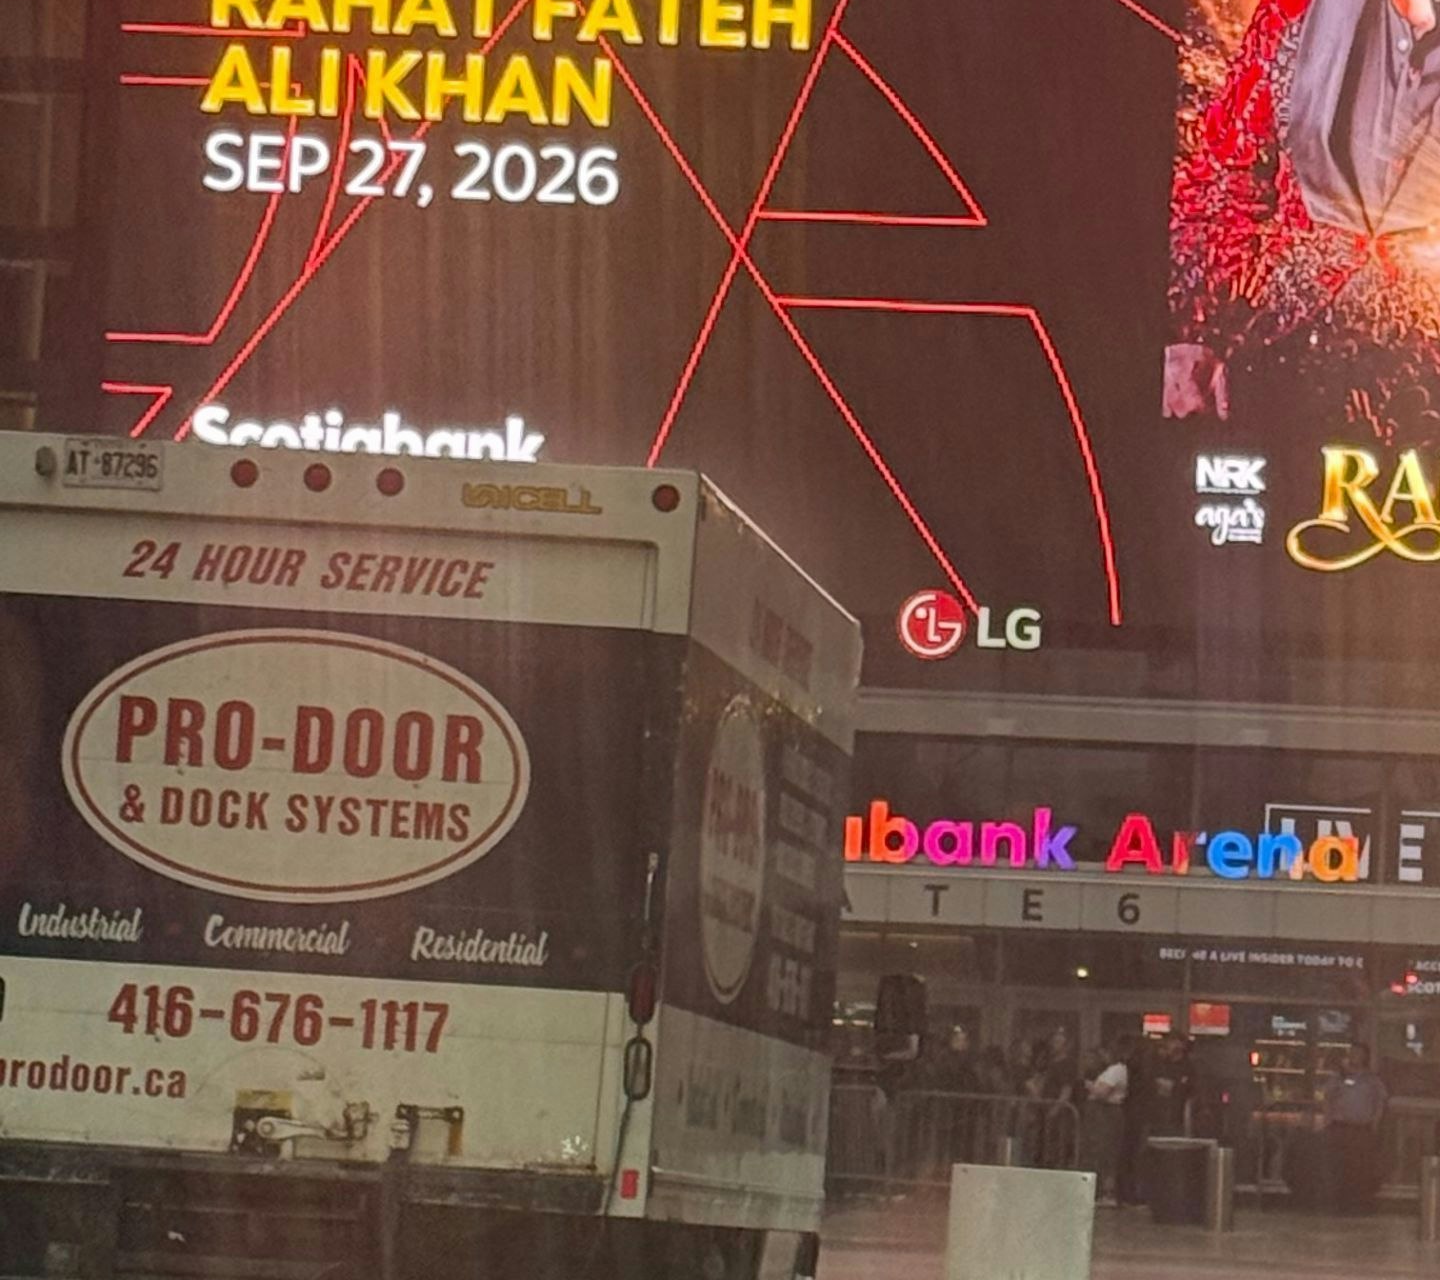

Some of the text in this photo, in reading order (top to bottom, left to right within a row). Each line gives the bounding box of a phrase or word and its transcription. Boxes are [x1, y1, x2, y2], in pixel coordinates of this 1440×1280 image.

[200, 44, 612, 128] ALI KHAN
[202, 132, 620, 207] SEP 27, 2026
[191, 404, 545, 464] Scotiabank
[1196, 455, 1267, 491] NRK
[122, 539, 495, 600] 24 HOUR SERVICE
[976, 606, 1042, 649] LG
[115, 693, 486, 784] PRO-DOOR
[119, 783, 472, 844] & DOCK SYSTEMS
[1106, 812, 1362, 883] Arena
[17, 902, 549, 968] Industrial Commercial Residential
[1117, 892, 1141, 924] 6
[107, 982, 451, 1055] 416-676-1117
